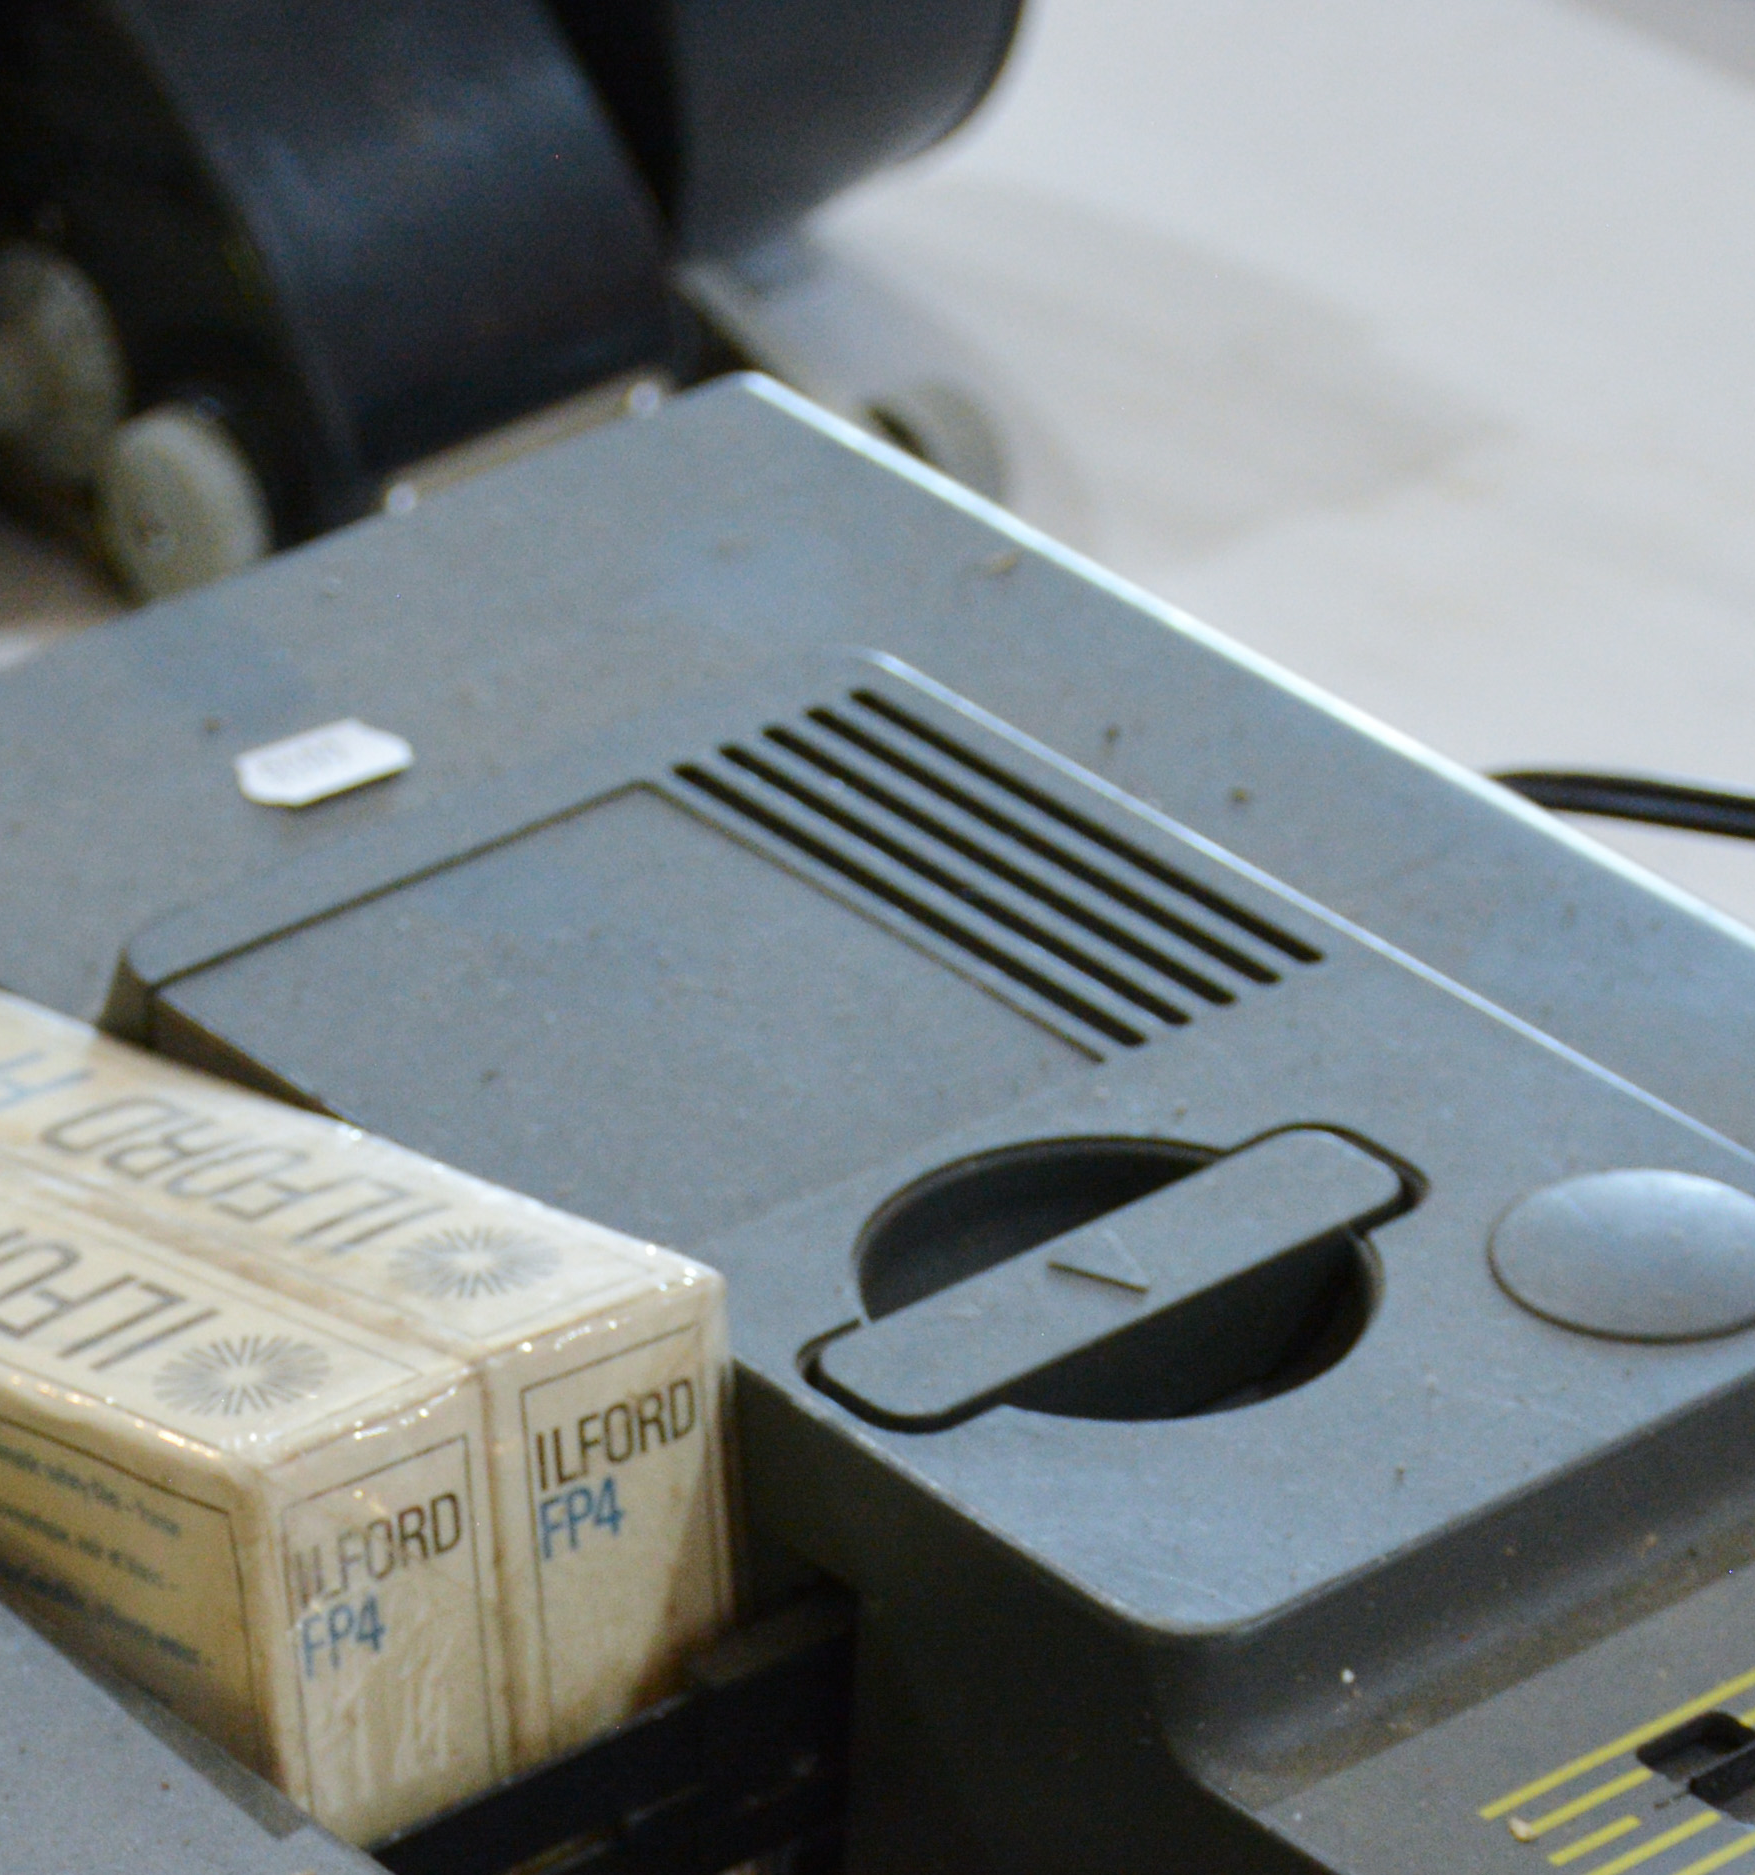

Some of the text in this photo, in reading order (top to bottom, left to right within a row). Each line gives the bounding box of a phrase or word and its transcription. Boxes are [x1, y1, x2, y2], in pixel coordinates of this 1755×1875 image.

[39, 1094, 449, 1256] ILFORD
[535, 1377, 698, 1492] ILFORD
[291, 1491, 463, 1611] ILFORD
[538, 1476, 626, 1562] FP4
[301, 1595, 386, 1681] FP4
